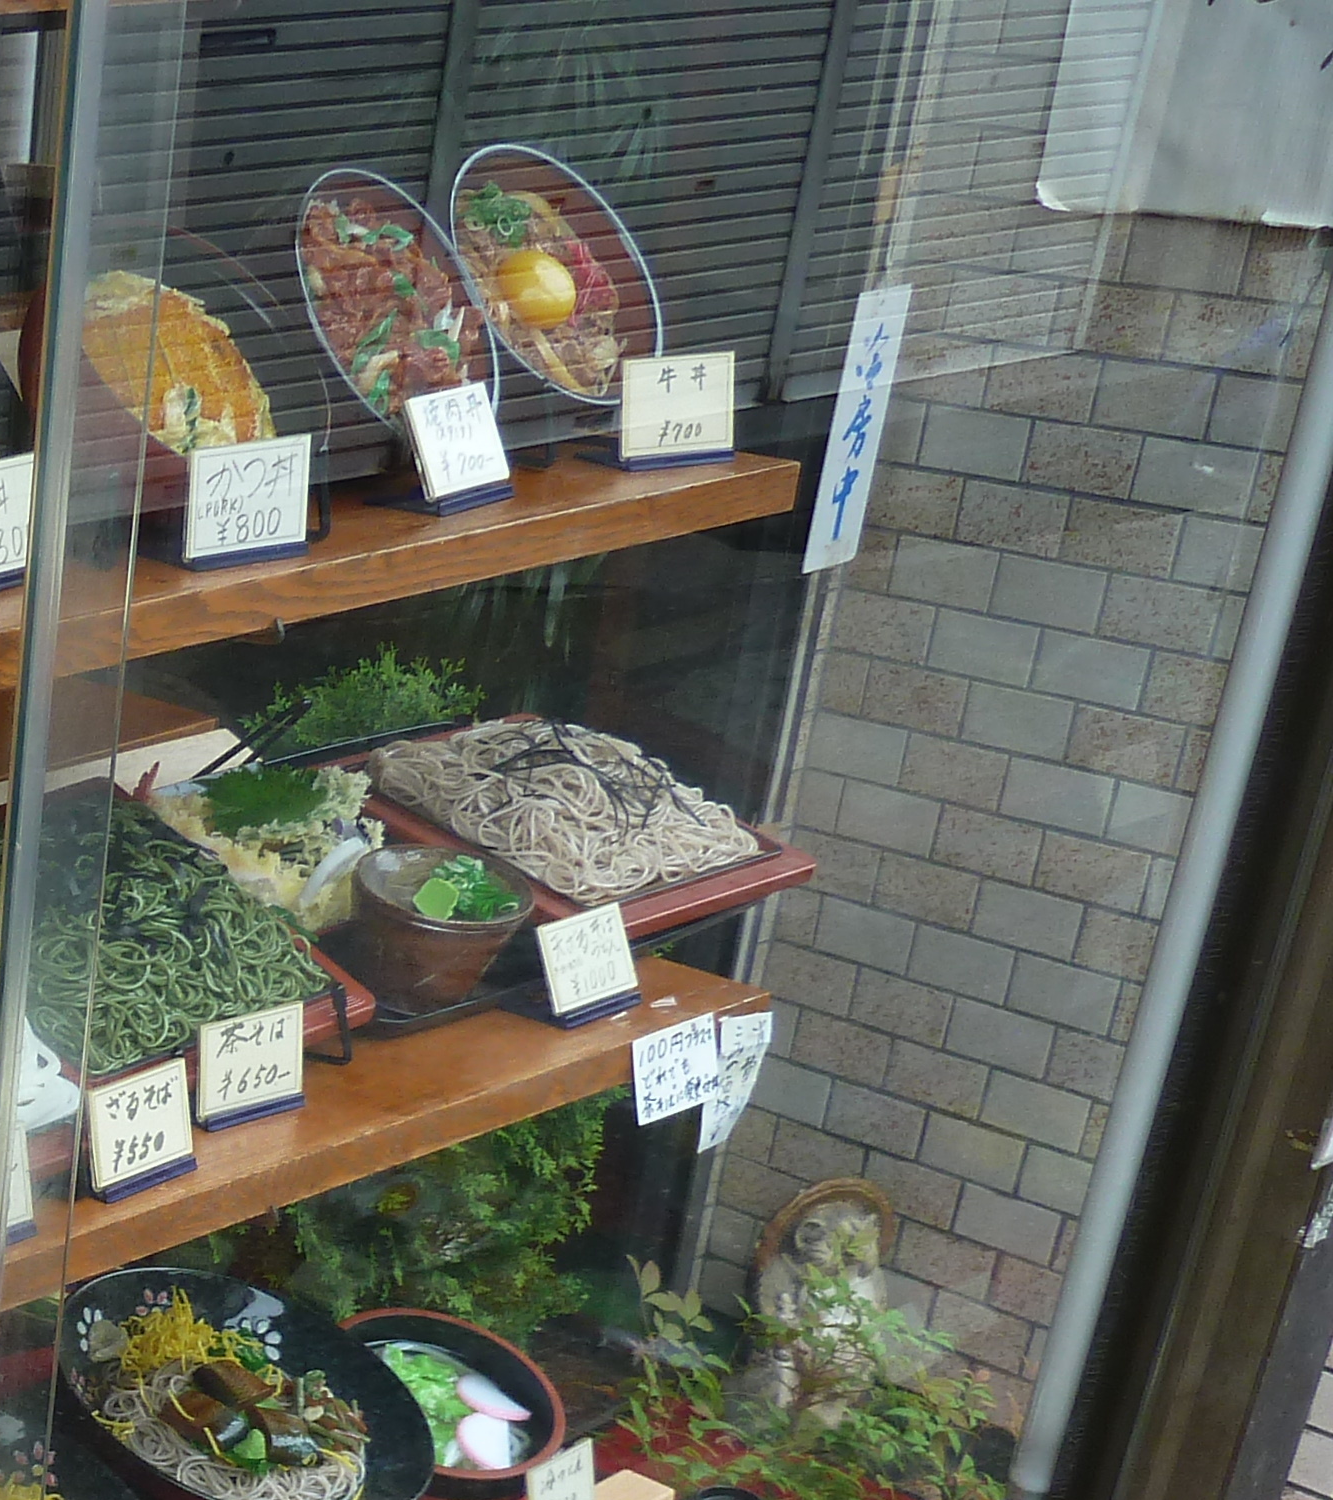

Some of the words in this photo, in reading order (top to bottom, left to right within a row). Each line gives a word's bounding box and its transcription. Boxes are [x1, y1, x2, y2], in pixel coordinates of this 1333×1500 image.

[657, 363, 707, 393] 牛丼
[658, 420, 702, 447] ¥700
[206, 453, 299, 501] かつ丼
[216, 507, 282, 546] ¥800
[113, 1130, 166, 1172] ¥550
